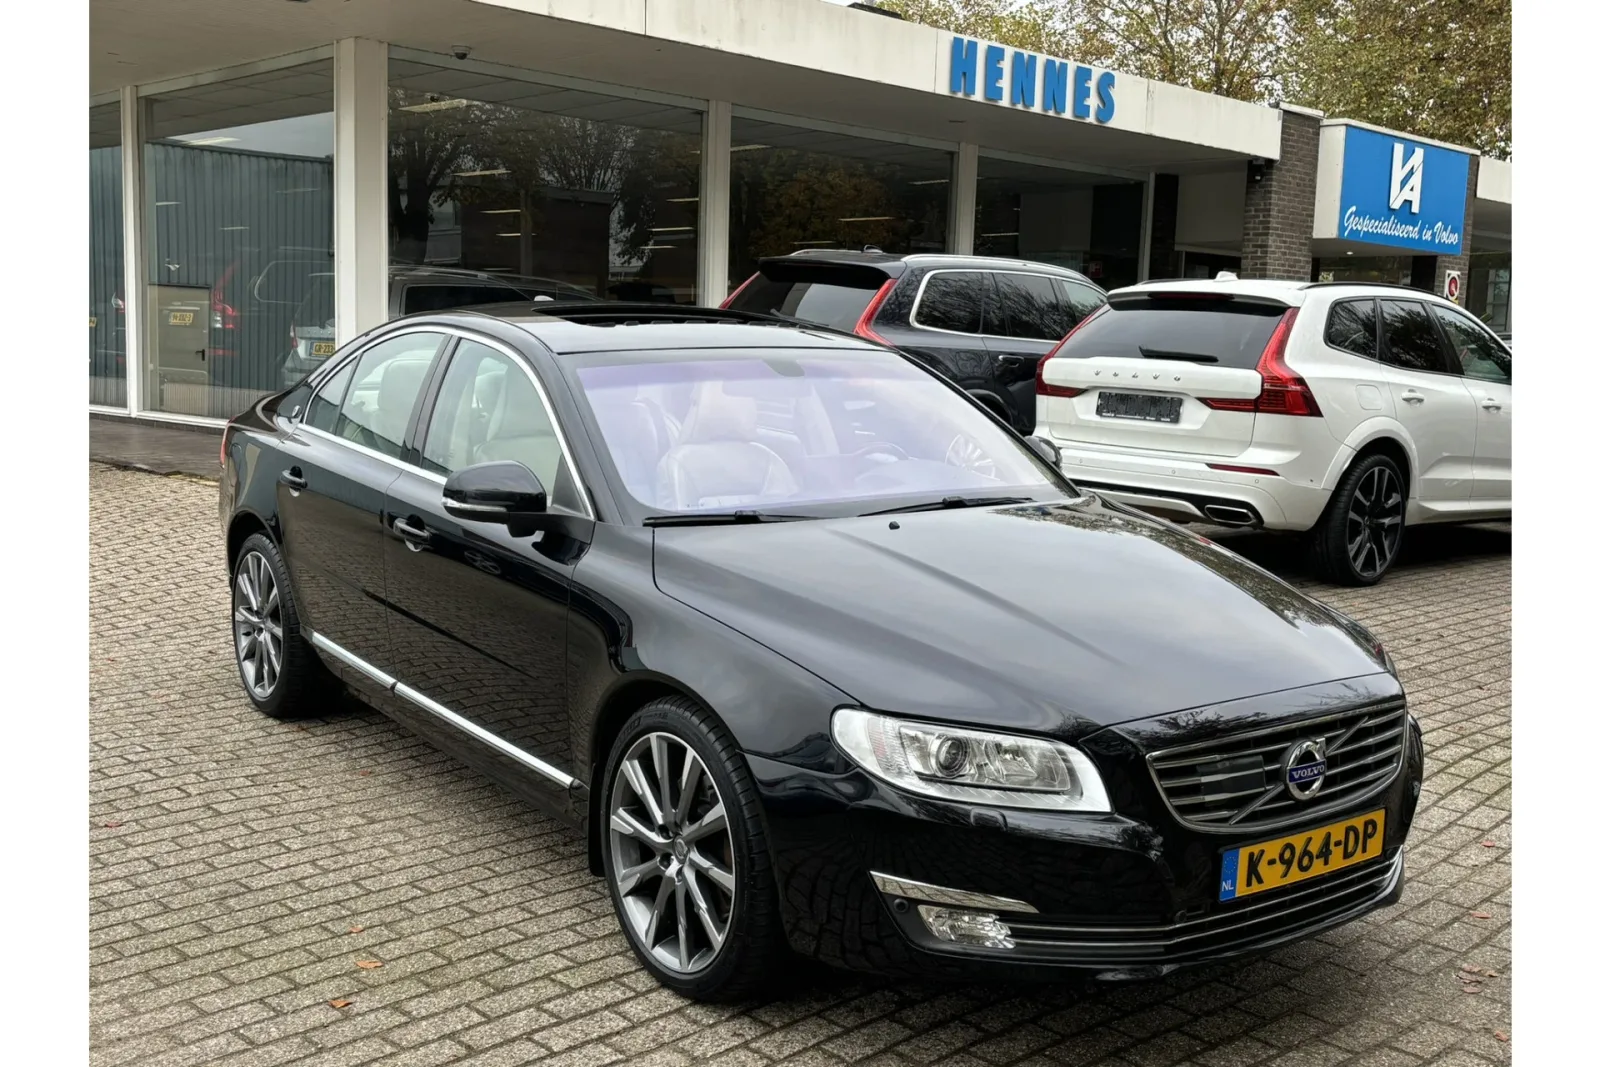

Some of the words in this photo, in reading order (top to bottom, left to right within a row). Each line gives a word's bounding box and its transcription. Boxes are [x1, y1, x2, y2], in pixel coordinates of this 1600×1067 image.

[950, 36, 1116, 123] HENNES
[1343, 205, 1421, 239] Gespecialiseerd
[1422, 223, 1432, 241] in
[1433, 221, 1459, 245] Volvo
[1094, 369, 1181, 381] VOLVO
[1292, 764, 1325, 779] VOLVO
[1246, 818, 1378, 888] K-964-DP
[1221, 879, 1235, 892] NL
